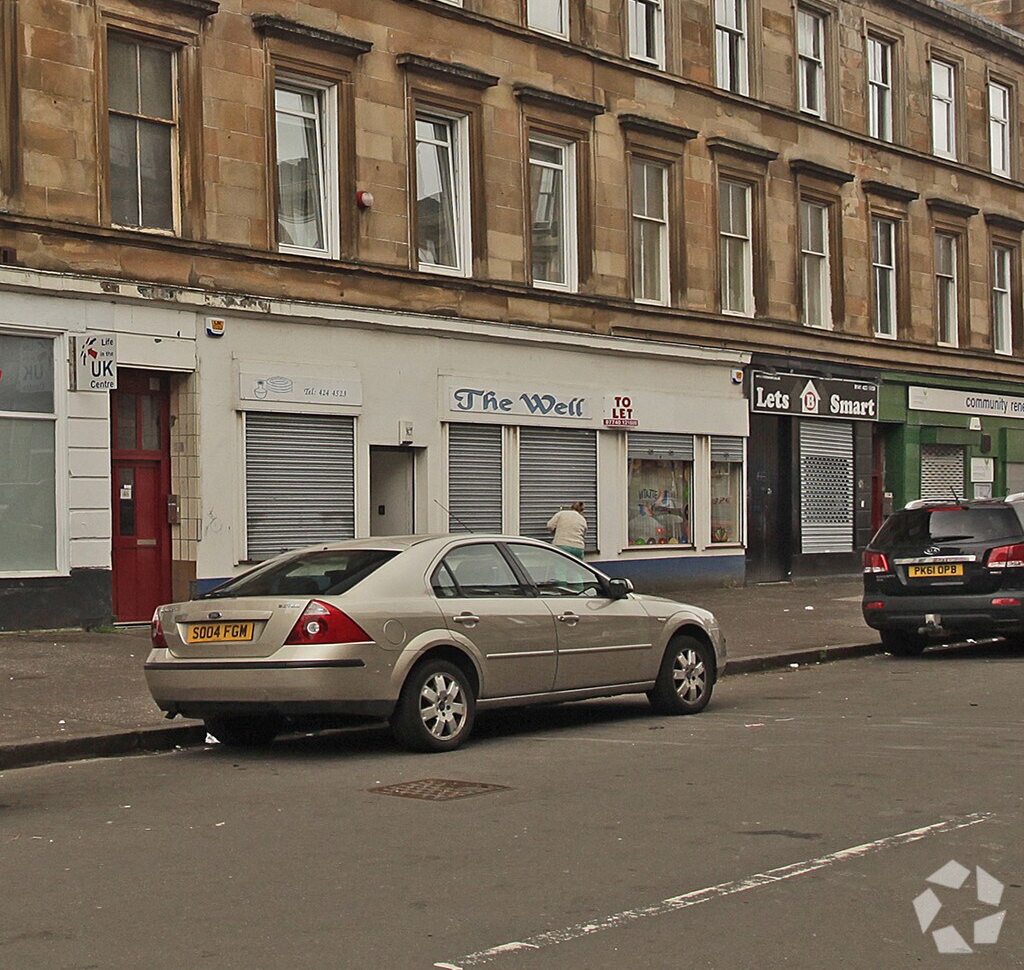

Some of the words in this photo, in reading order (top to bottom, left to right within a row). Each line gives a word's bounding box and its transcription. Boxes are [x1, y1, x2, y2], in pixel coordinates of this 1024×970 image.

[101, 338, 114, 346] Life
[91, 360, 114, 377] UK
[90, 380, 114, 389] Centre
[453, 388, 513, 411] The
[519, 393, 585, 416] Well
[614, 396, 631, 408] TO
[756, 387, 790, 409] Lets
[806, 394, 815, 408] B
[830, 394, 875, 416] Smart
[965, 397, 1008, 414] community
[612, 408, 633, 419] LET
[914, 565, 935, 575] PK61
[937, 564, 957, 574] OPB
[224, 624, 248, 637] FGM
